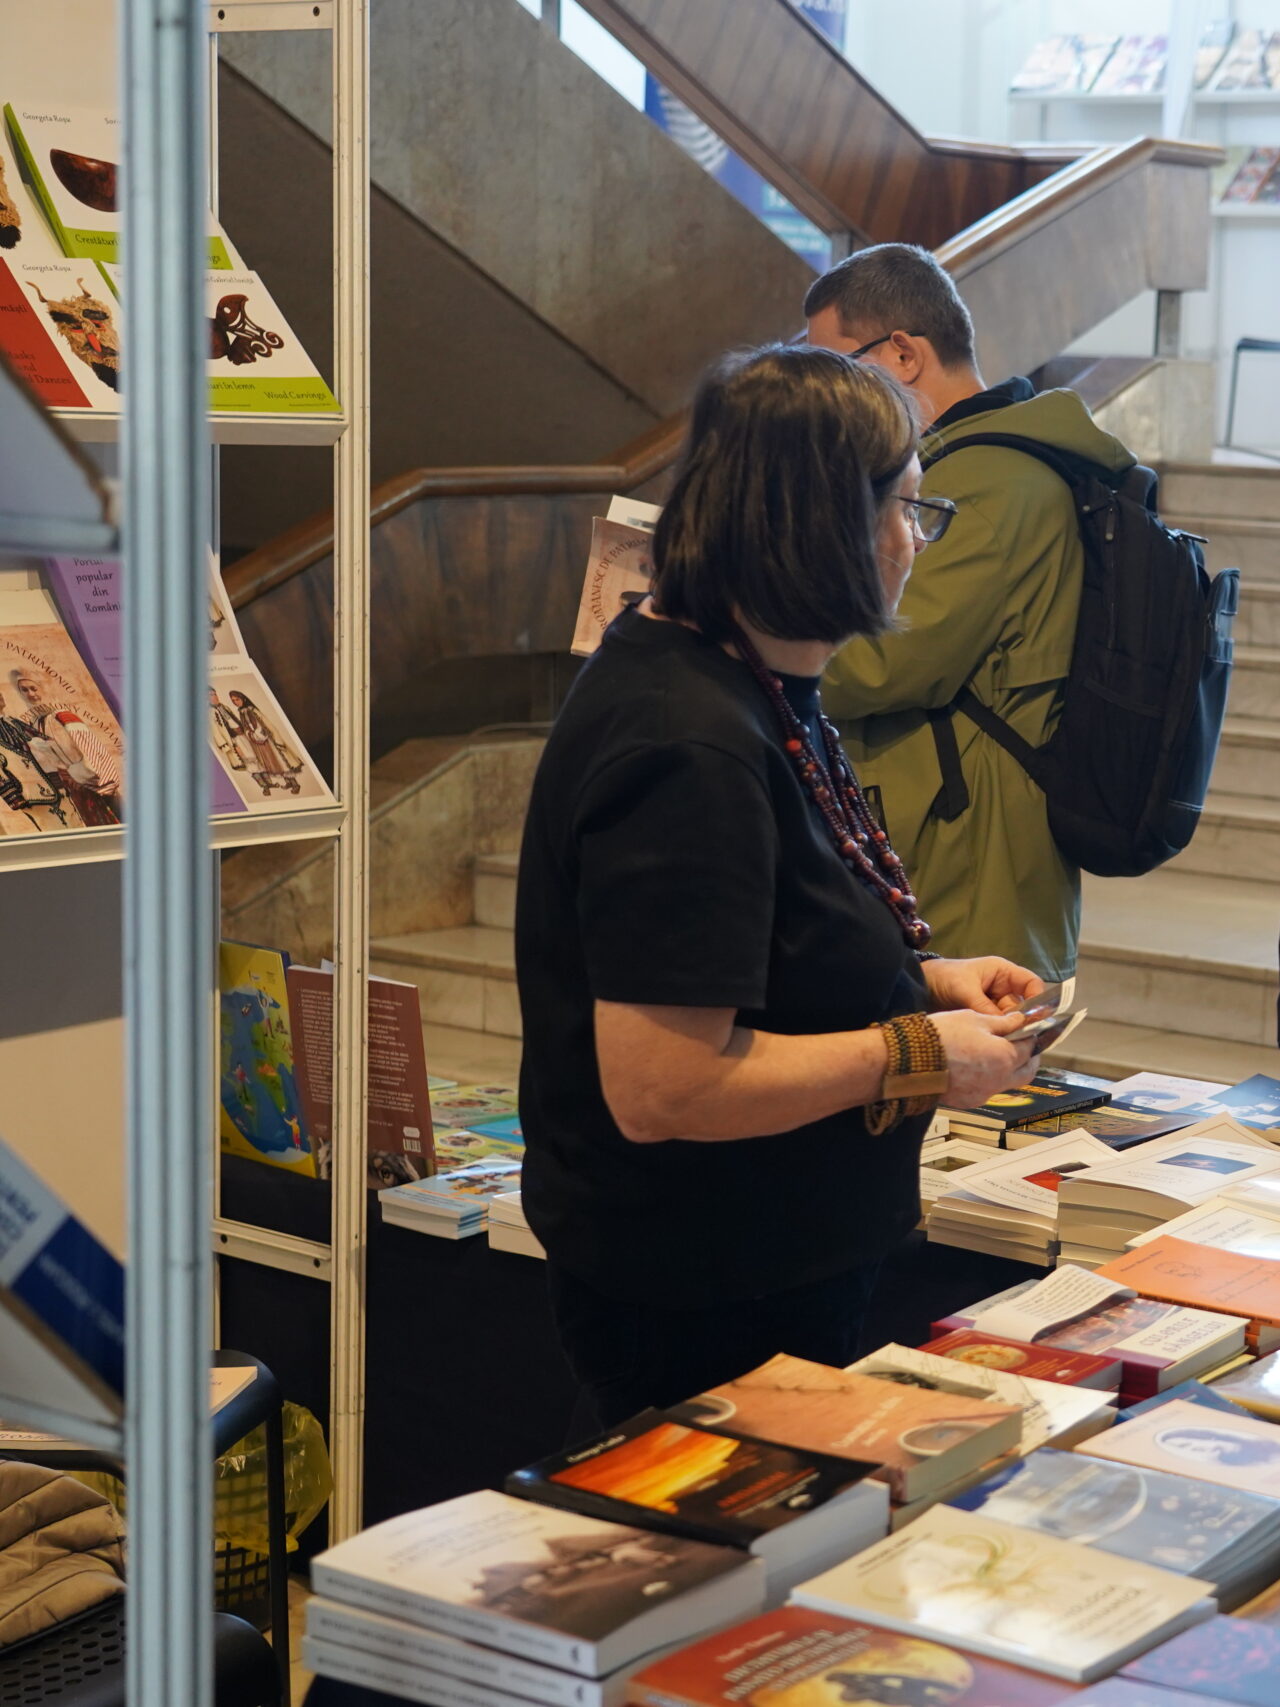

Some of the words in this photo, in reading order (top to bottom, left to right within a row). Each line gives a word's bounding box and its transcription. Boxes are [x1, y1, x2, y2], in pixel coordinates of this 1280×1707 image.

[76, 569, 113, 584] popular
[92, 585, 109, 597] din
[6, 641, 77, 695] PATRIMONIU
